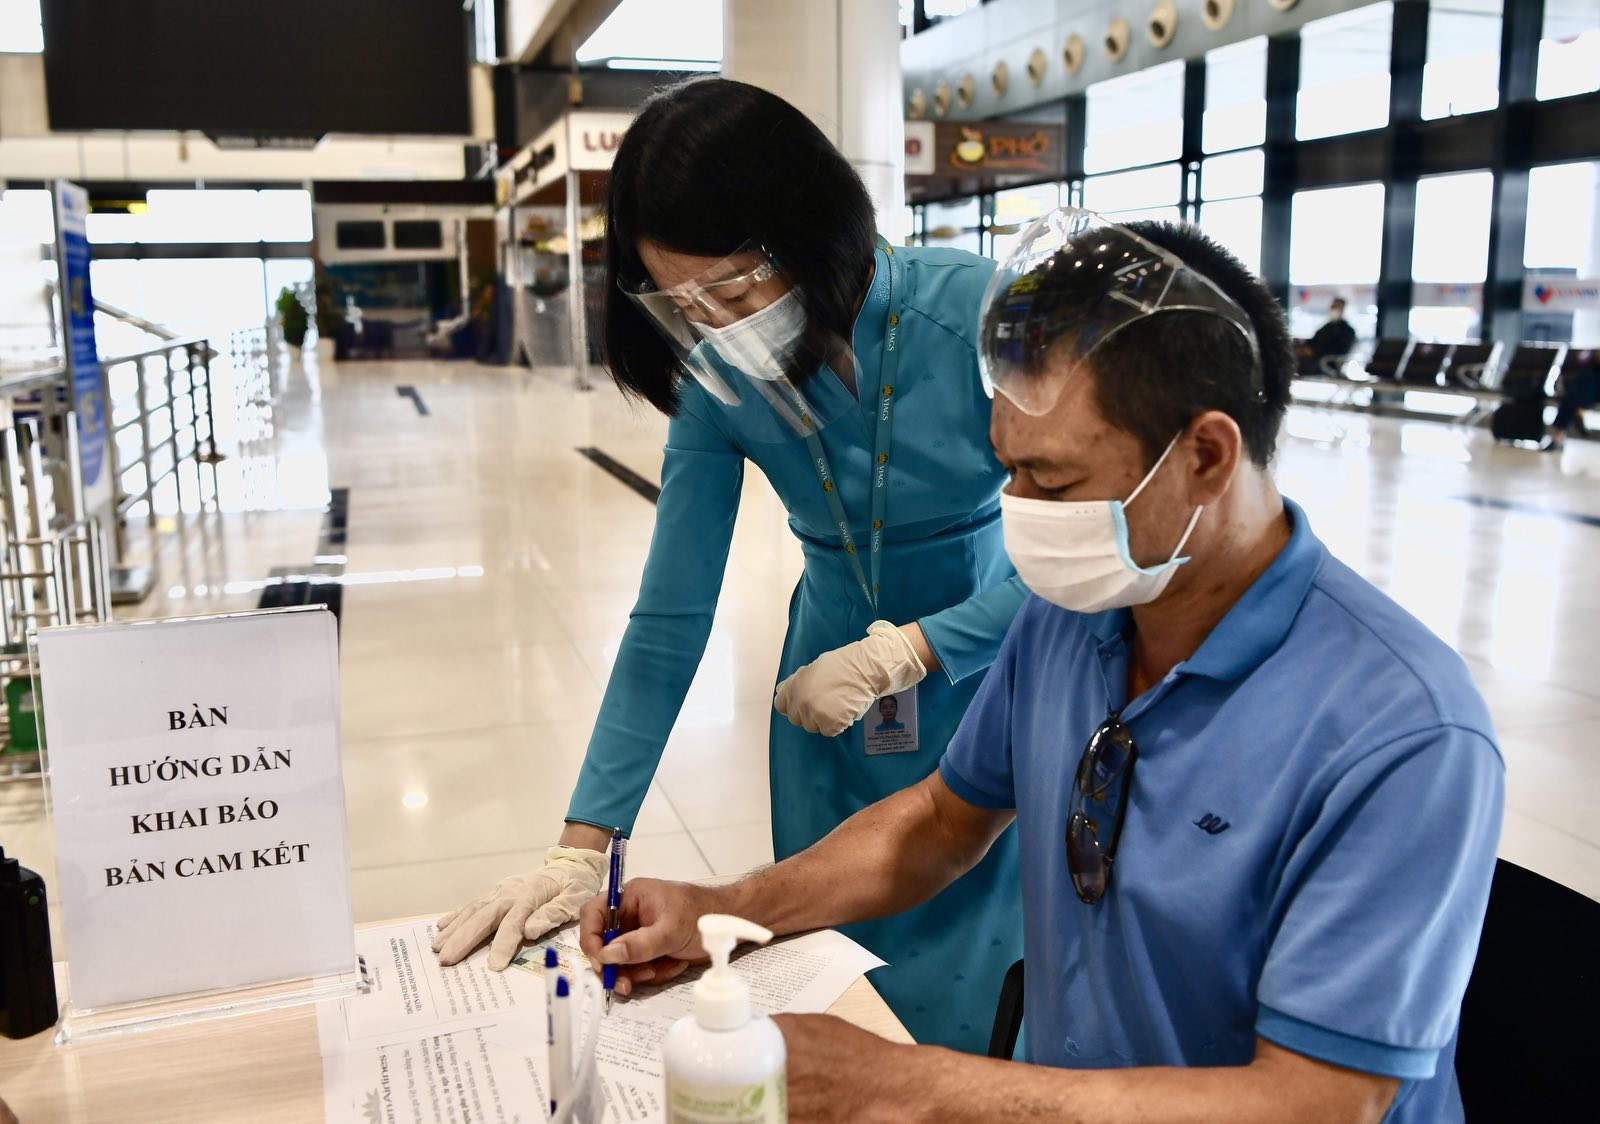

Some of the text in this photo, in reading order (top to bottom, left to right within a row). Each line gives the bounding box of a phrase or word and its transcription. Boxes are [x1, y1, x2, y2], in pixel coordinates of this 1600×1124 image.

[888, 327, 897, 352] VIAGS
[882, 398, 890, 421] VIAGS
[817, 457, 829, 481] VIAGS
[877, 465, 885, 488] VIAGS
[168, 703, 228, 731] BÀN
[109, 746, 292, 787] HƯỚNG DẪN
[131, 796, 279, 834] KHAI BÁO
[105, 840, 310, 887] BẢN CAM KẾT
[379, 1054, 393, 1103] Airlines
